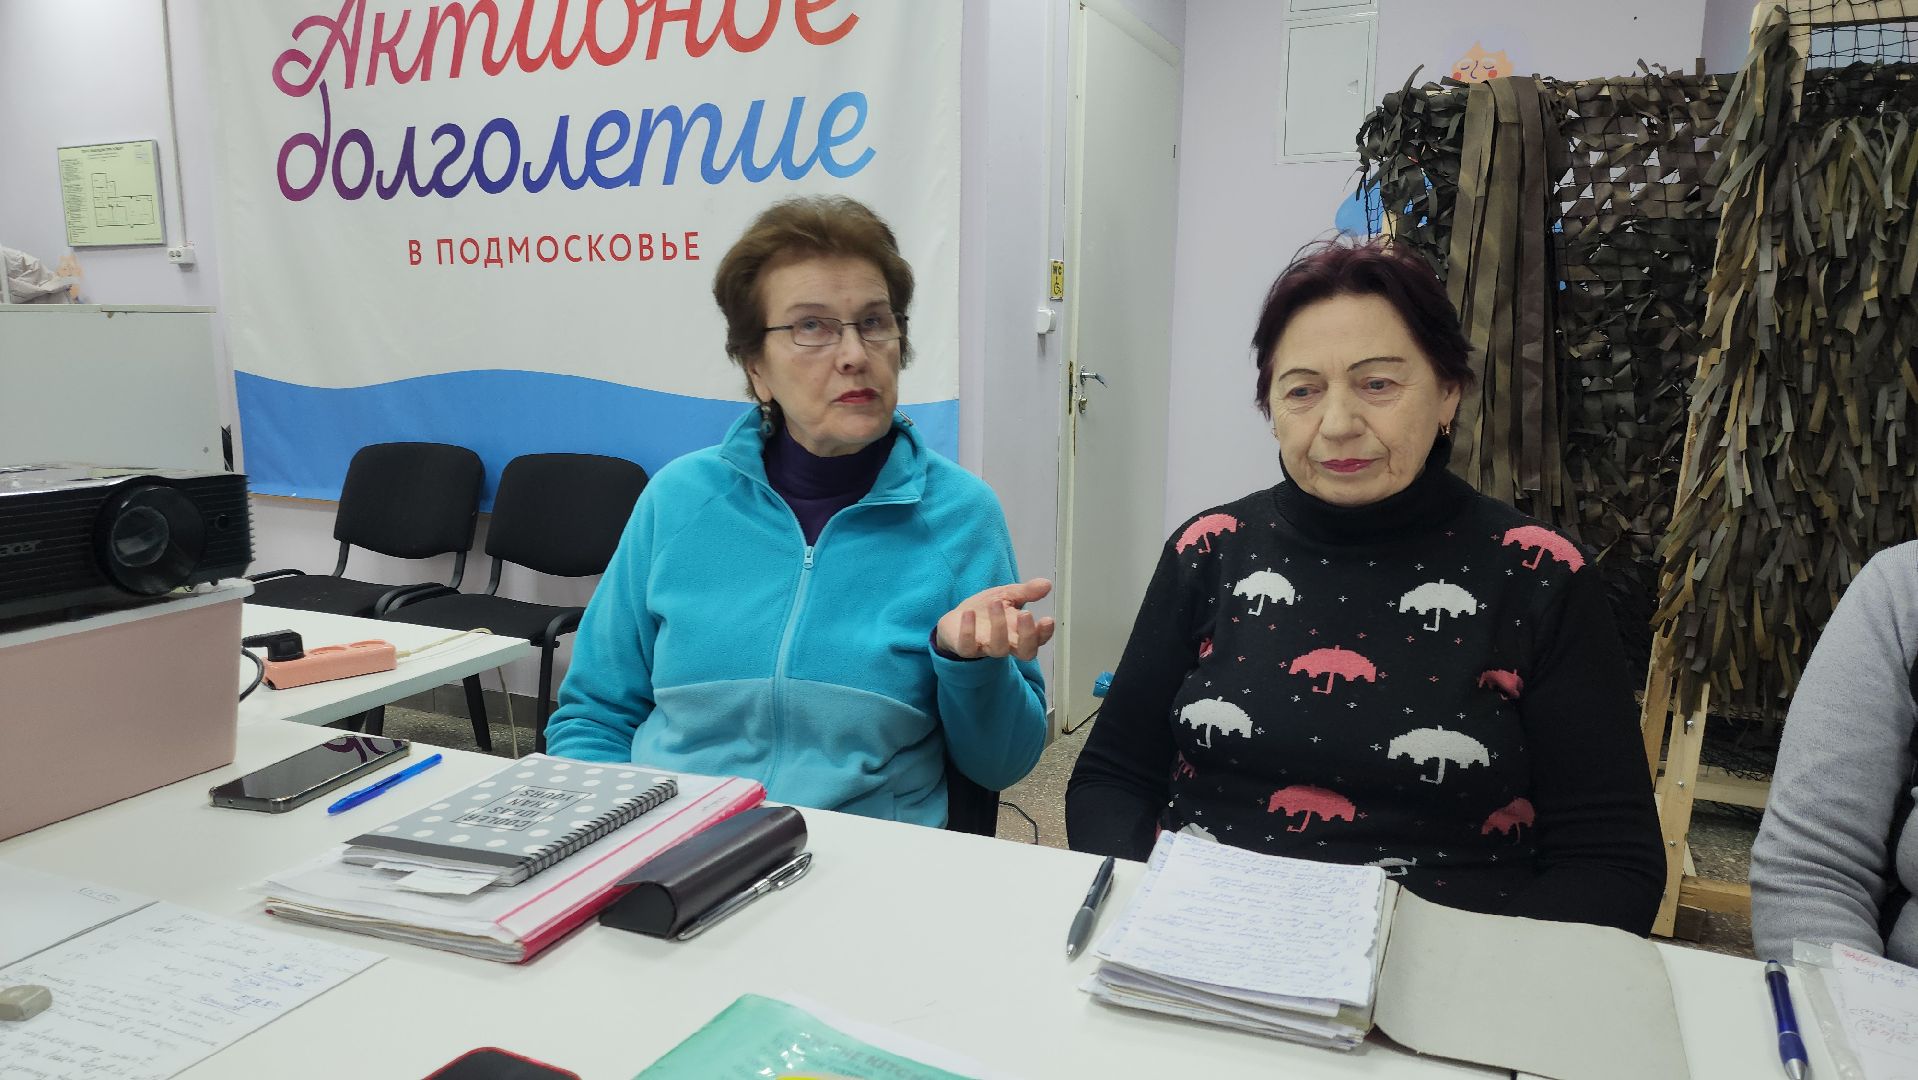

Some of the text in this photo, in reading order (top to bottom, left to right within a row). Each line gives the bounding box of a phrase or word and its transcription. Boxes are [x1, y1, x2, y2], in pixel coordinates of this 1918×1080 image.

[277, 79, 876, 201] долголетие
[408, 231, 700, 268] В ПОДМОСКОВЬЕ
[1052, 265, 1063, 276] WC
[519, 789, 574, 801] YOURS
[508, 798, 555, 810] THAN
[488, 806, 541, 818] IDEAS
[463, 813, 532, 828] COOLER
